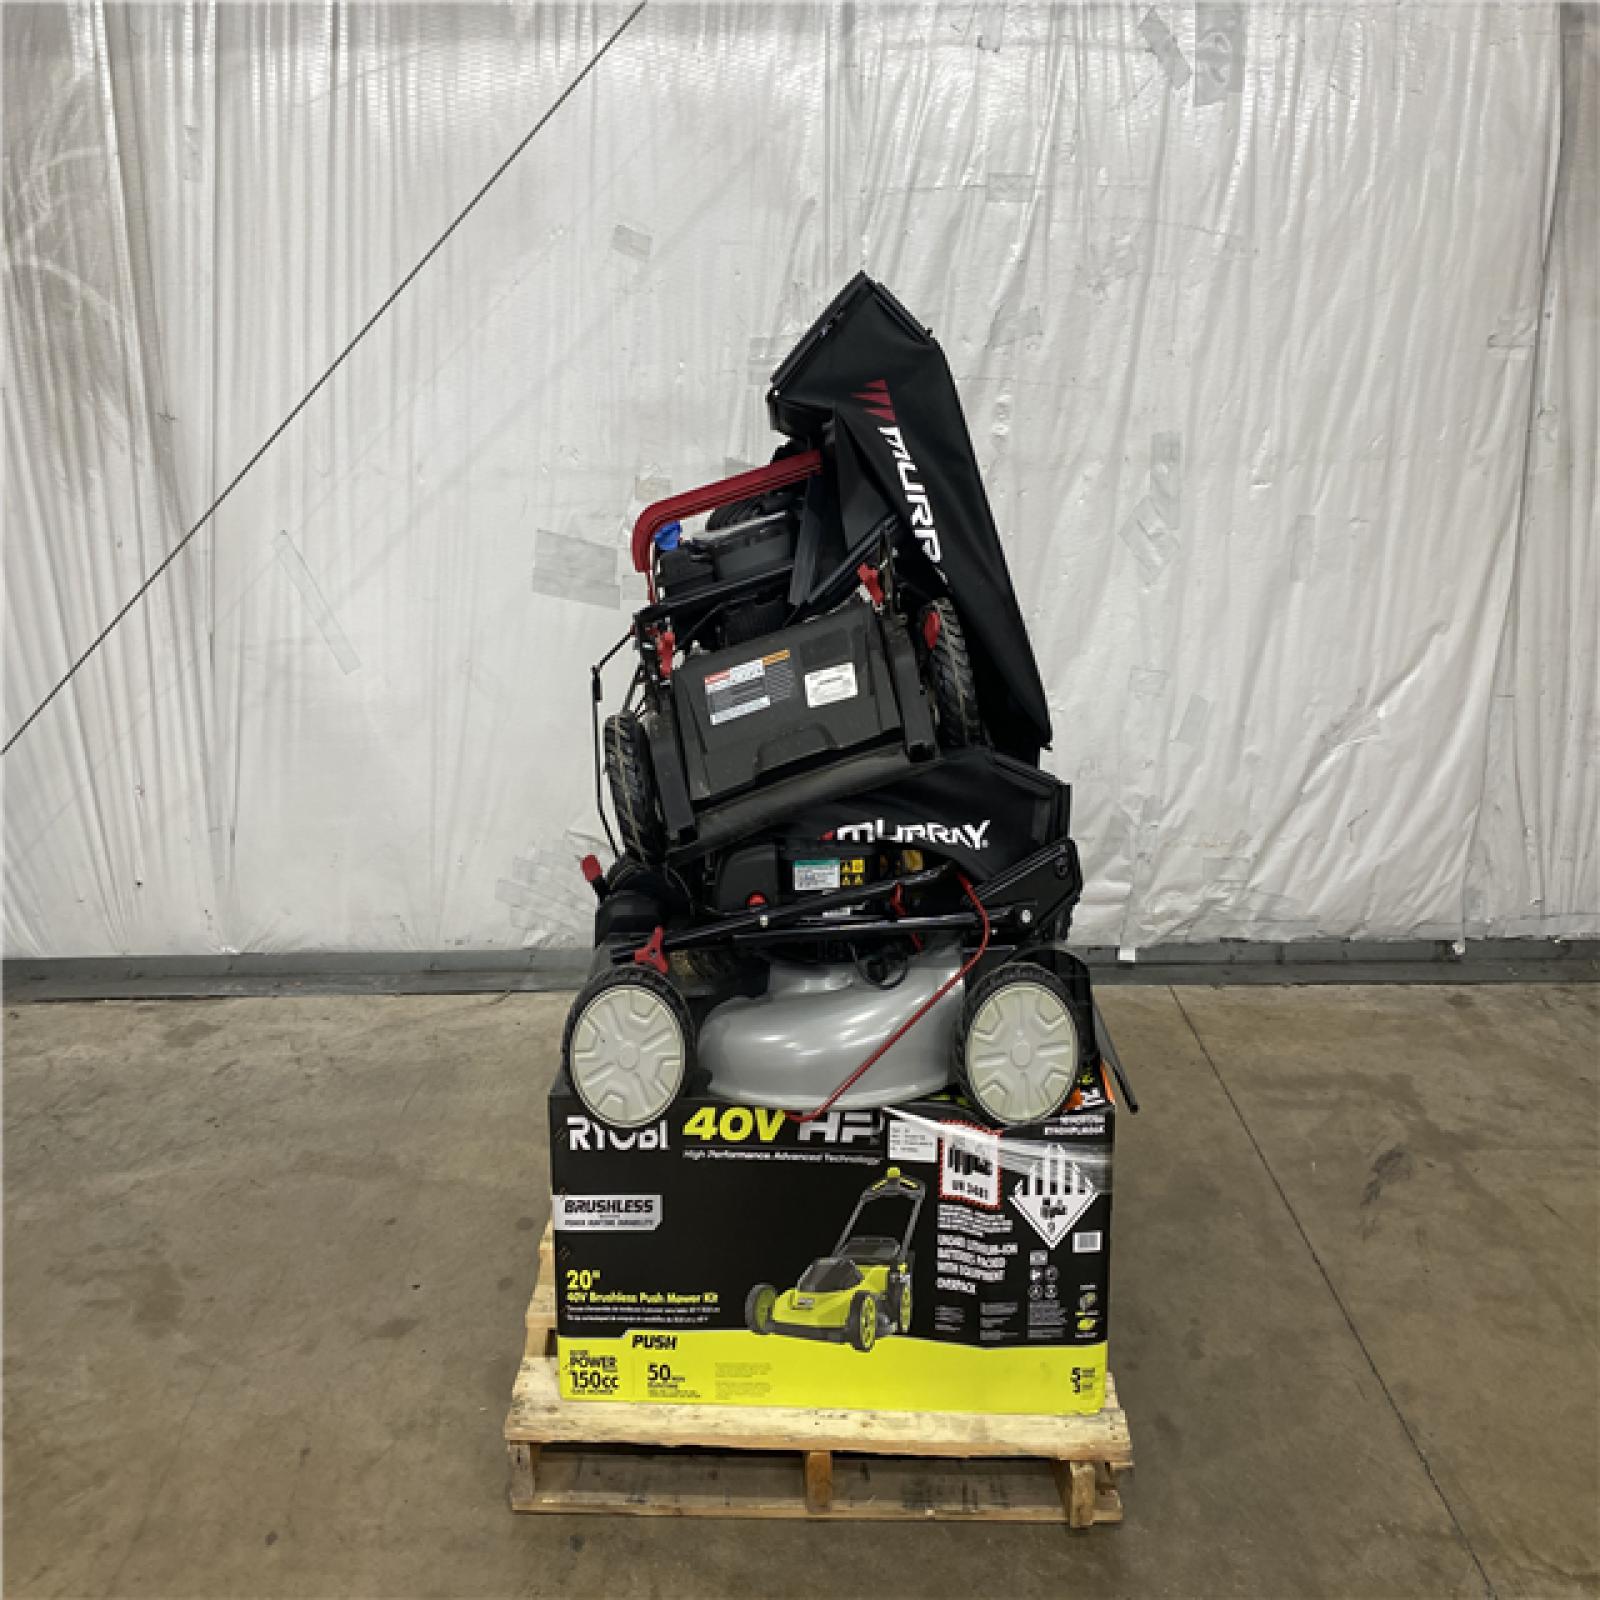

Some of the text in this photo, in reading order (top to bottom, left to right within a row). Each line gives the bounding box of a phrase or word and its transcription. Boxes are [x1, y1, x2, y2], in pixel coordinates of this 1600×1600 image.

[682, 1106, 786, 1143] 40V
[564, 1199, 654, 1213] BRUSHLESS
[566, 1269, 601, 1290] 20"
[632, 1335, 678, 1350] PUSH
[569, 1370, 620, 1388] 150cc
[647, 1363, 671, 1381] 50
